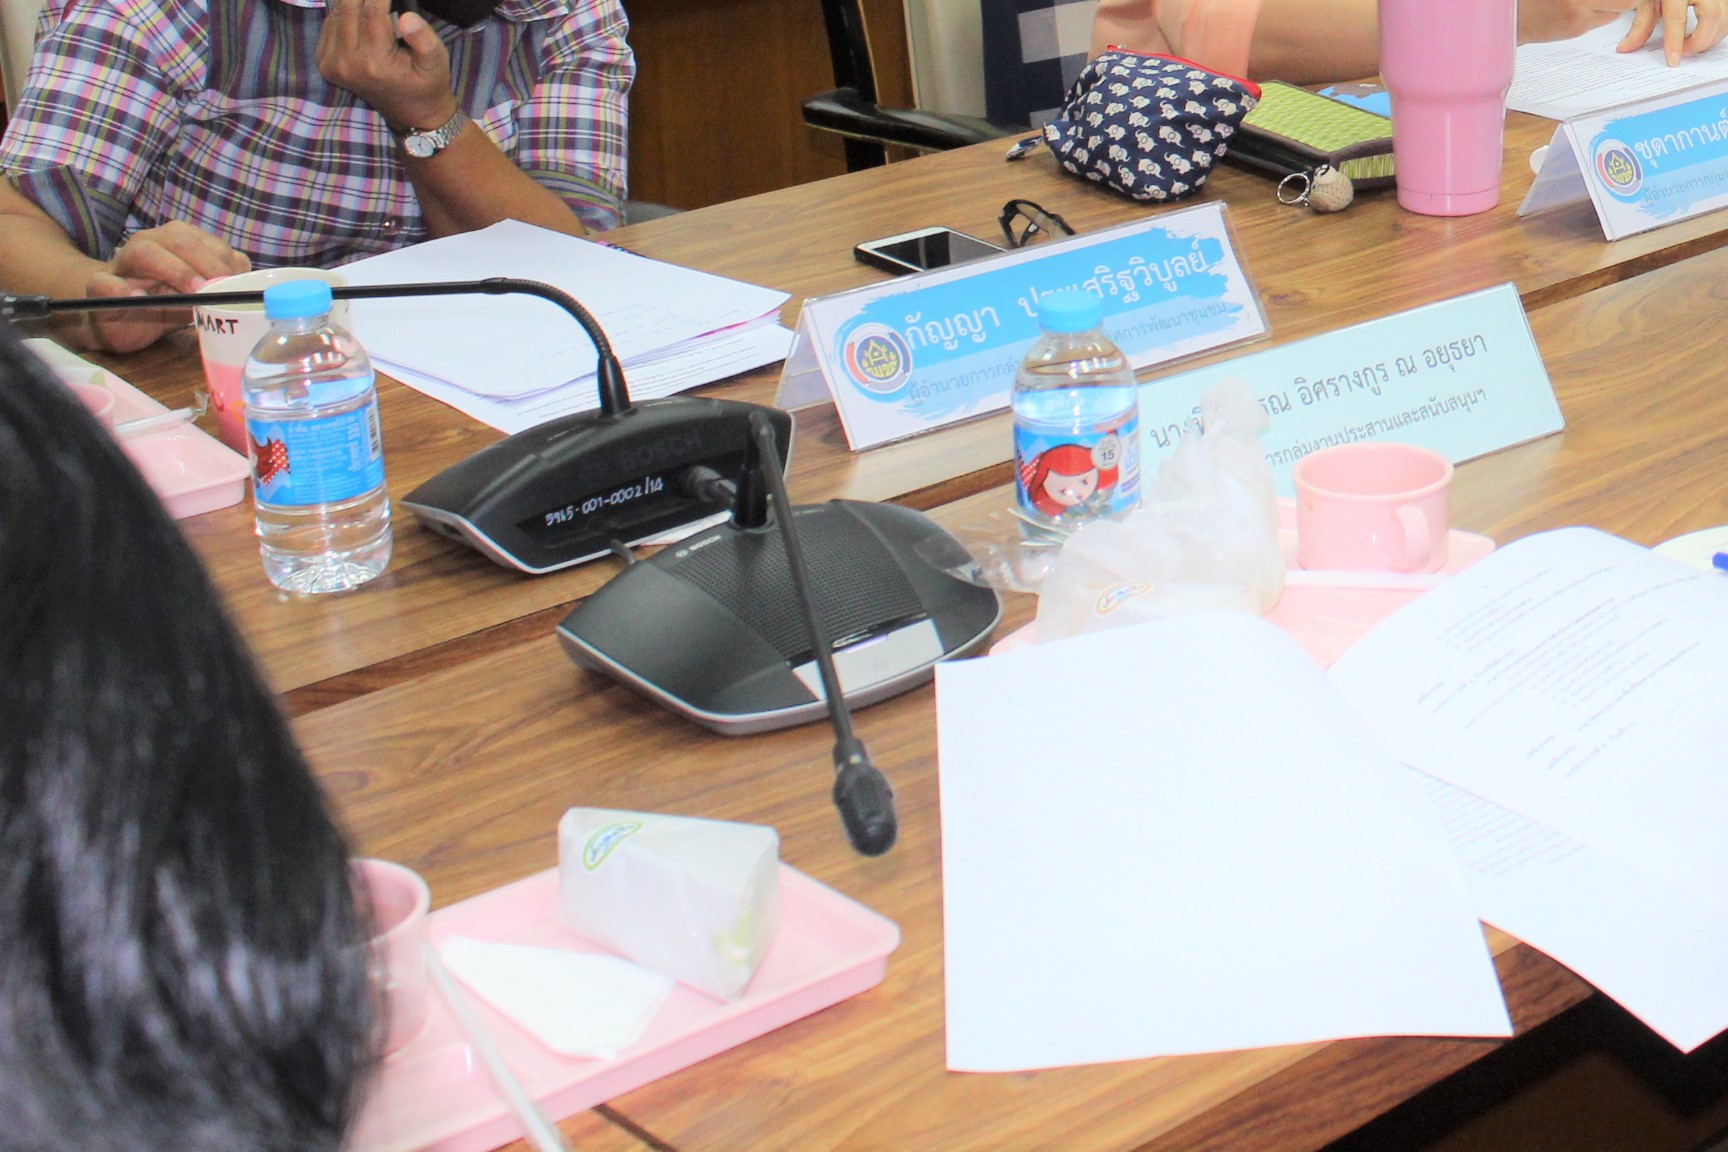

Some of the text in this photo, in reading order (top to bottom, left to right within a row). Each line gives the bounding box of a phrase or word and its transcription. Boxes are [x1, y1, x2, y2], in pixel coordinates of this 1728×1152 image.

[904, 307, 1001, 351] กัญญา
[1293, 362, 1390, 406] อิศรางกูร
[1395, 355, 1418, 377] ณ
[1422, 334, 1489, 373] อยุธยา
